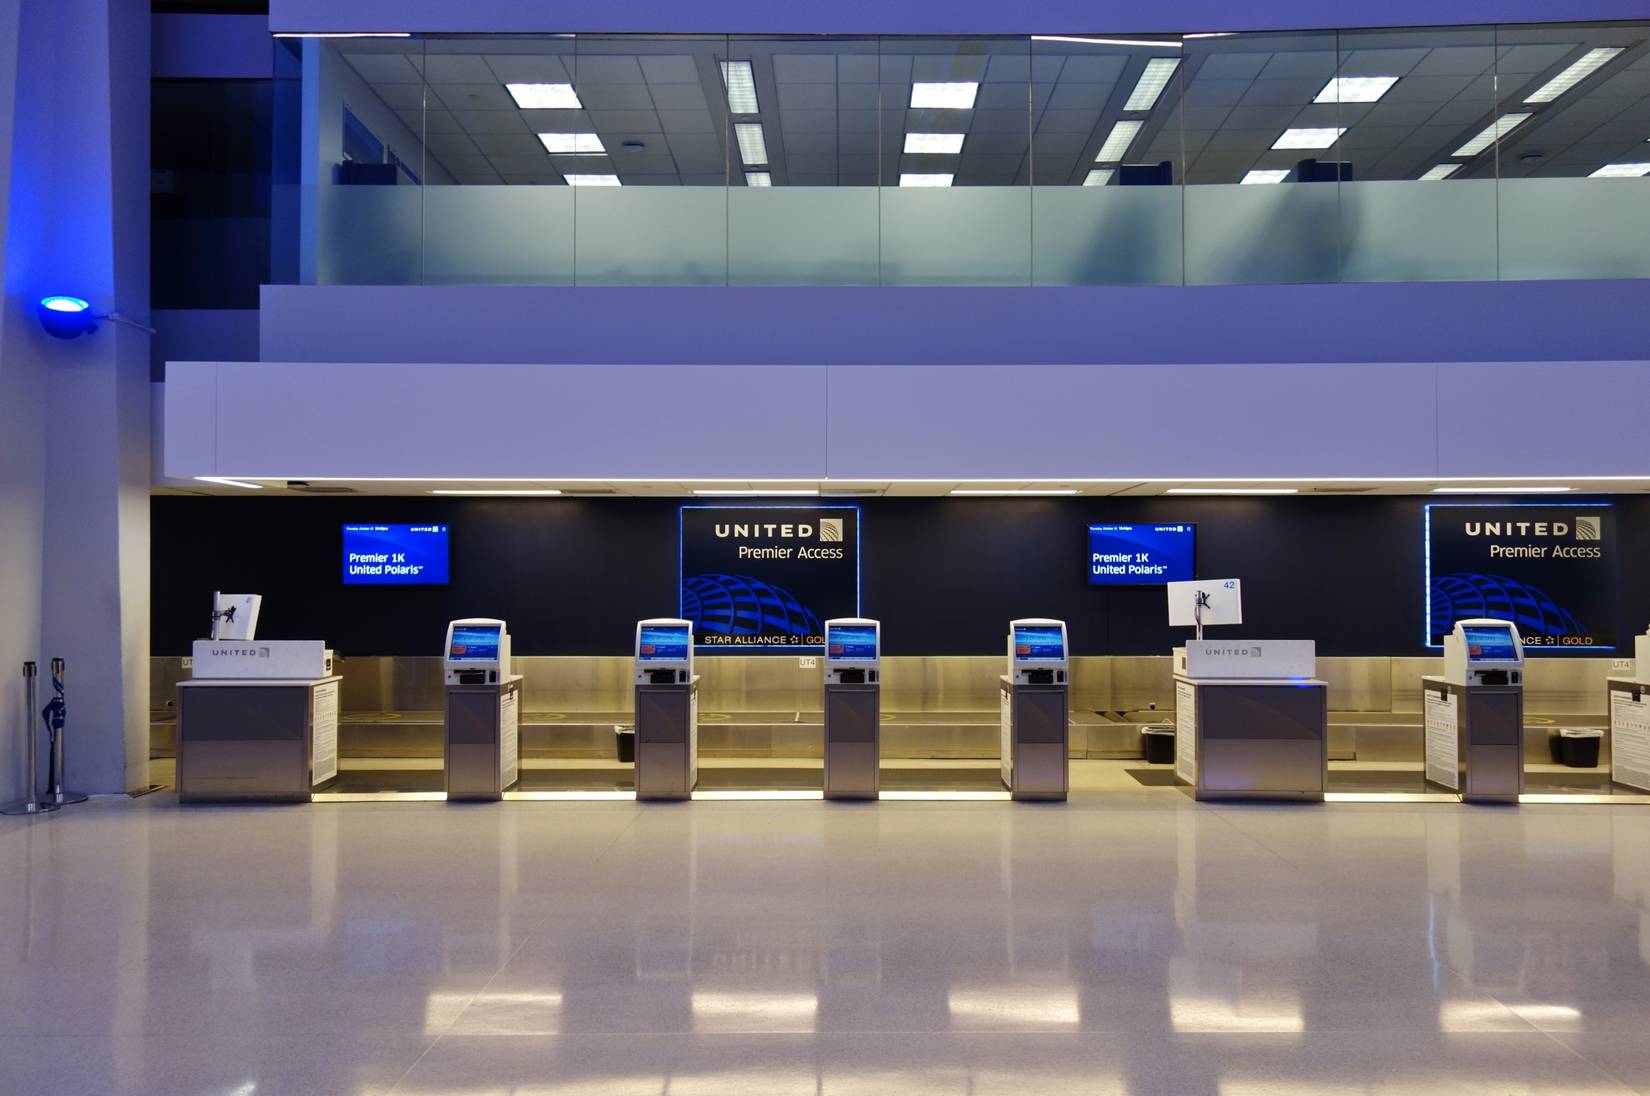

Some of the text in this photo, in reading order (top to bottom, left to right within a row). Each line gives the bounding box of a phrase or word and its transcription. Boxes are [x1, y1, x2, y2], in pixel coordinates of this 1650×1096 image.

[715, 524, 813, 538] UNITED
[1465, 522, 1569, 536] UNITED
[739, 546, 843, 559] Premier Access
[1490, 544, 1600, 558] Premier Access
[349, 553, 405, 562] Premier 1K
[1092, 553, 1149, 562] Premier 1K
[349, 565, 382, 574] United
[1092, 565, 1125, 574] United
[1224, 581, 1235, 589] 42
[704, 635, 825, 644] STAR ALLIANCE GOL
[1562, 636, 1593, 645] GOLD
[183, 658, 192, 666] UT
[800, 658, 815, 667] UT4
